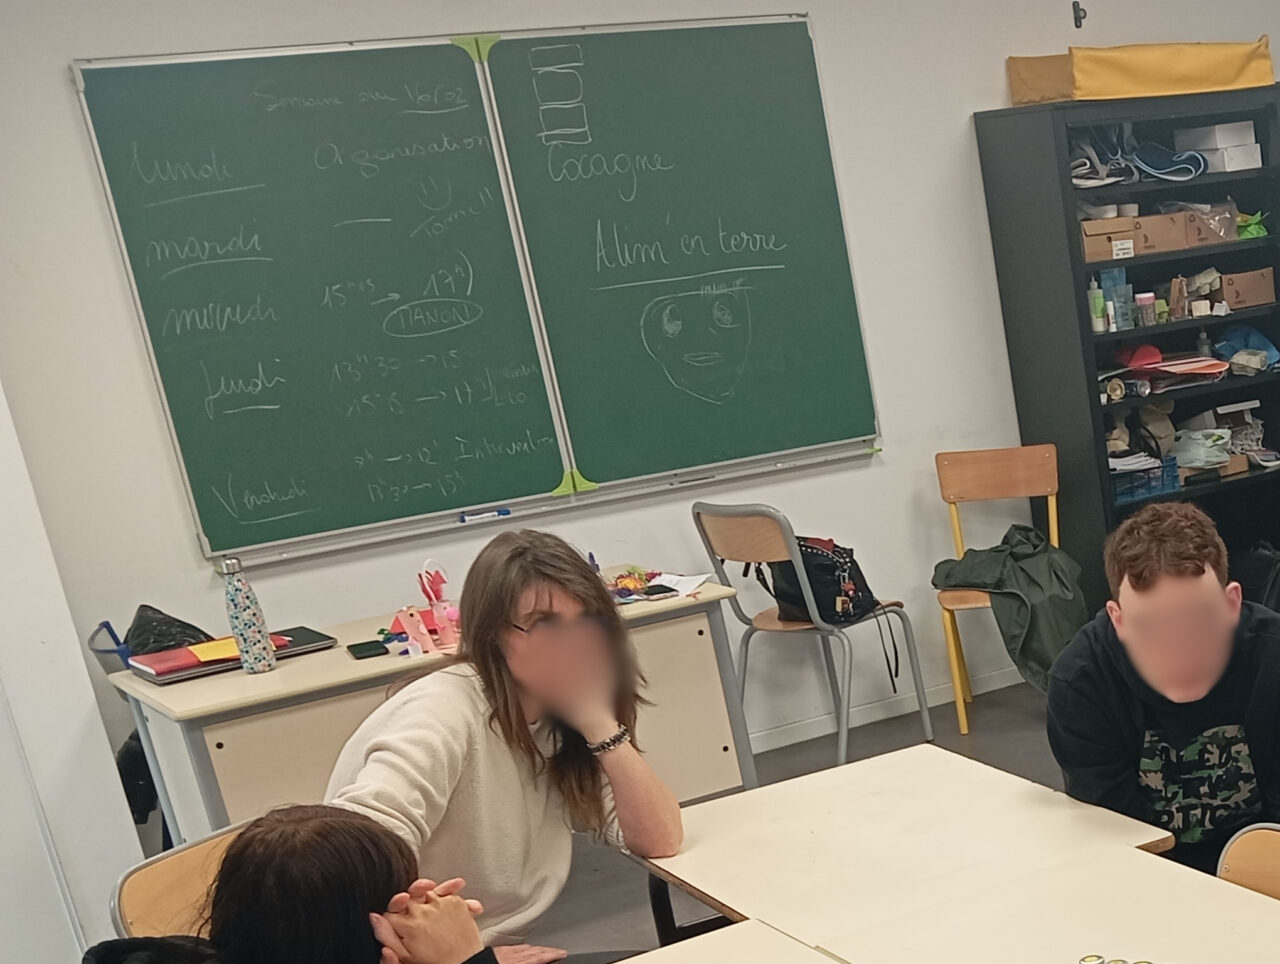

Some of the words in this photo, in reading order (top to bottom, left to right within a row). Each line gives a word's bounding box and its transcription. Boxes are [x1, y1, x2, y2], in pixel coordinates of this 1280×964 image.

[548, 142, 675, 202] Cocagne
[145, 218, 262, 267] mardi
[718, 216, 787, 254] terre
